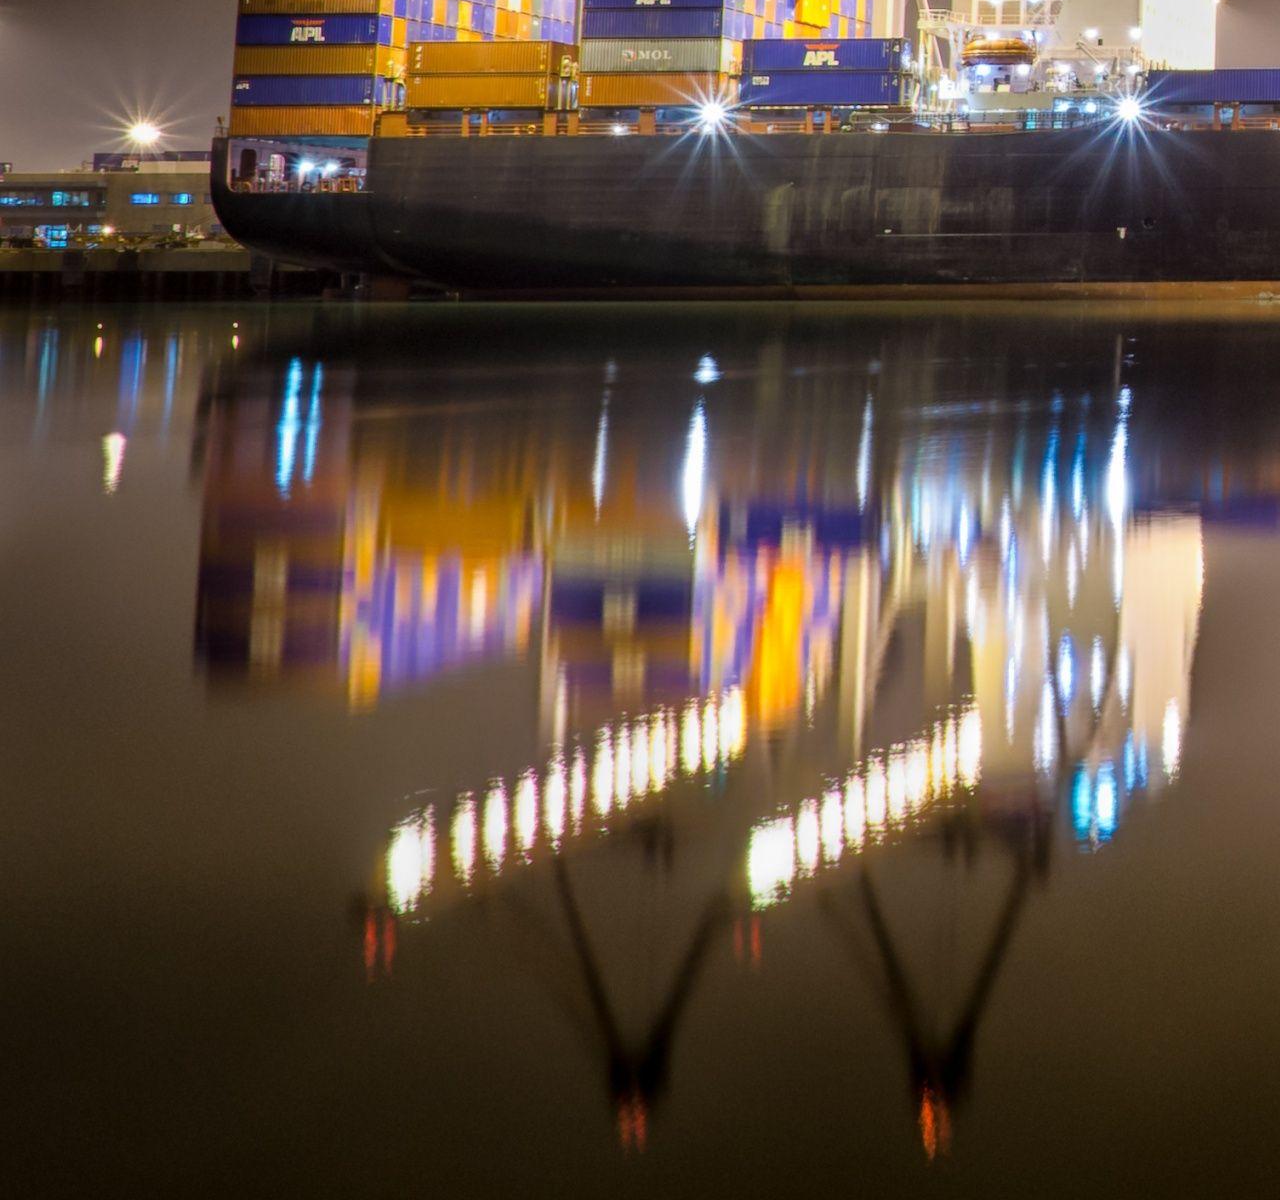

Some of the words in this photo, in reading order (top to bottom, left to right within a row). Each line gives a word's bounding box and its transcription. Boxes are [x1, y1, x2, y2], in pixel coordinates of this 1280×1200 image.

[291, 27, 325, 41] APL
[638, 50, 672, 60] MOL
[804, 51, 840, 66] APL
